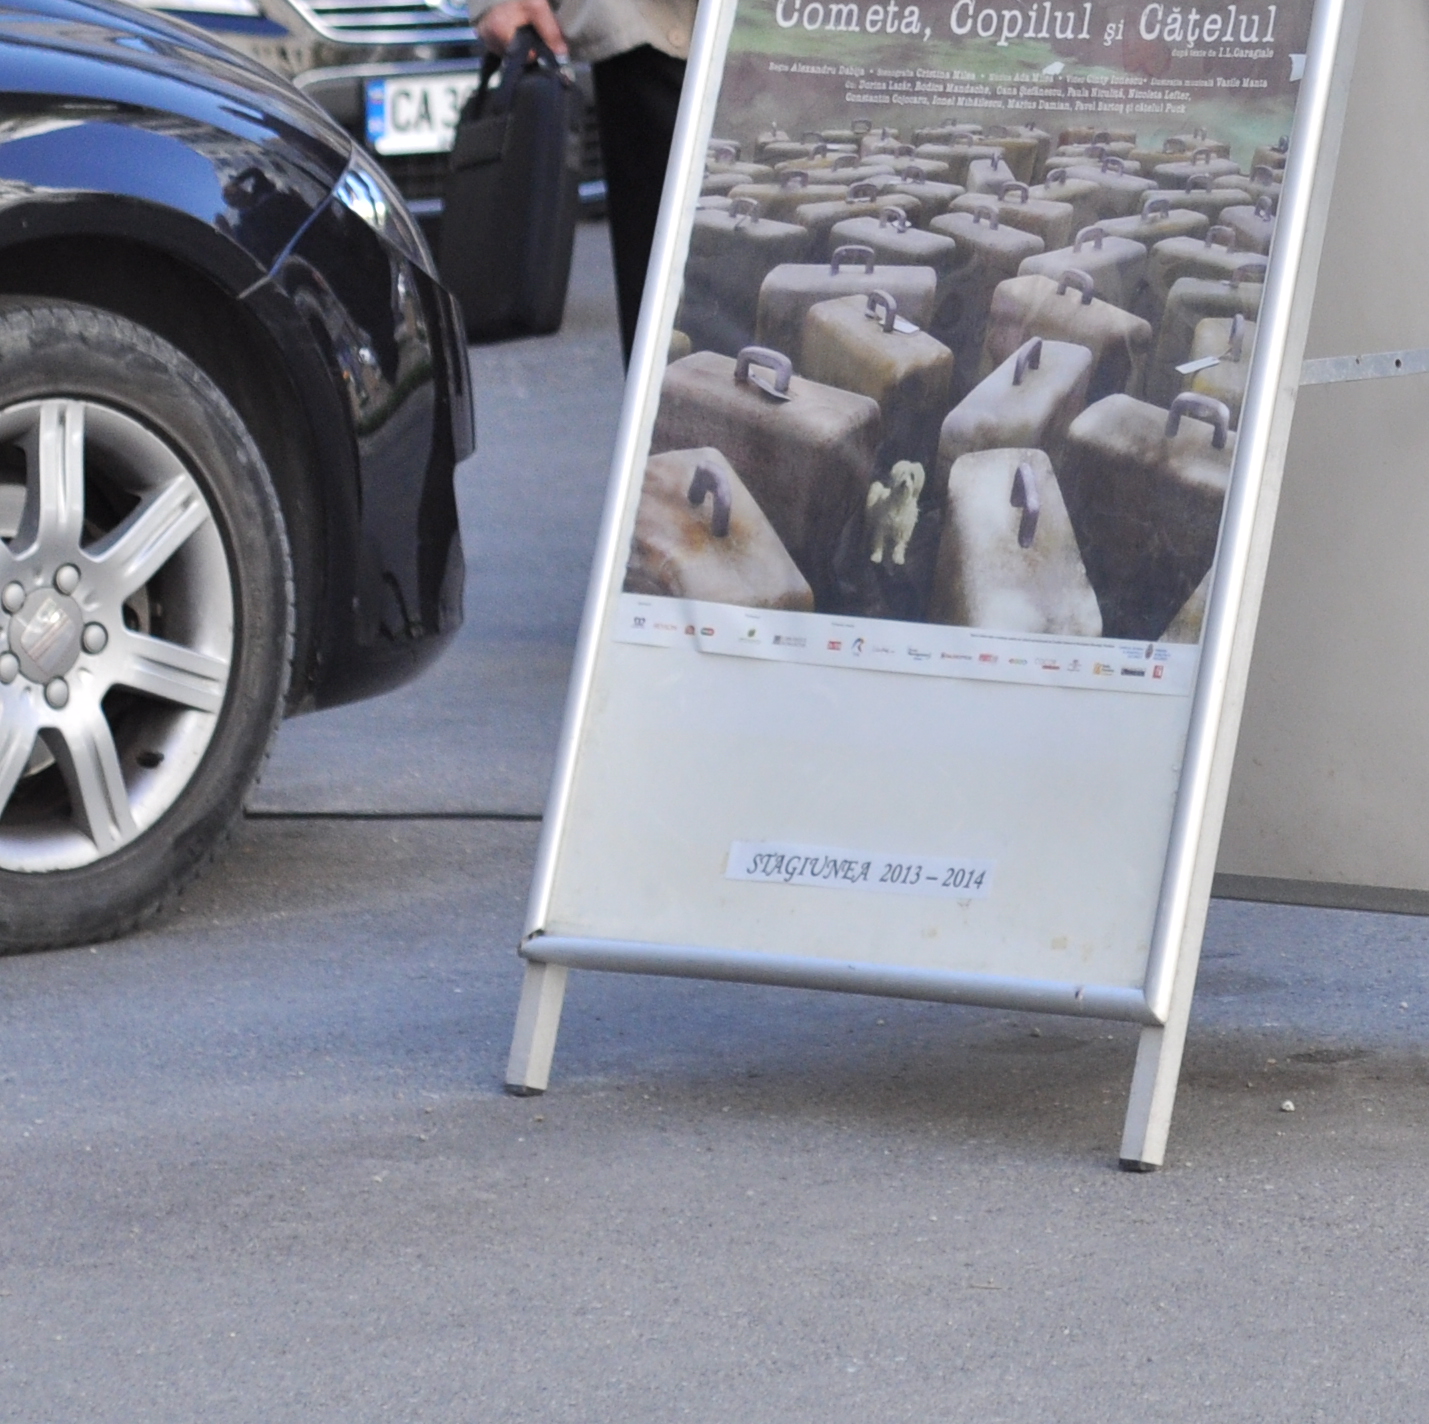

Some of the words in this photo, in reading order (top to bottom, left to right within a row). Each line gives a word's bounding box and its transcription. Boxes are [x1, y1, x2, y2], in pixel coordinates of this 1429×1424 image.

[790, 62, 836, 75] Alexandru
[916, 68, 950, 79] Cristina
[1216, 77, 1240, 88] Vasile
[858, 80, 887, 90] Dorina
[914, 81, 943, 92] Rodica
[1067, 87, 1089, 97] Paula
[845, 92, 890, 103] Constantin
[1007, 98, 1037, 109] Marius
[1165, 103, 1186, 114] Puck
[746, 851, 872, 883] STAGIUNEA
[879, 863, 923, 885] 2013
[941, 867, 987, 889] 2014
